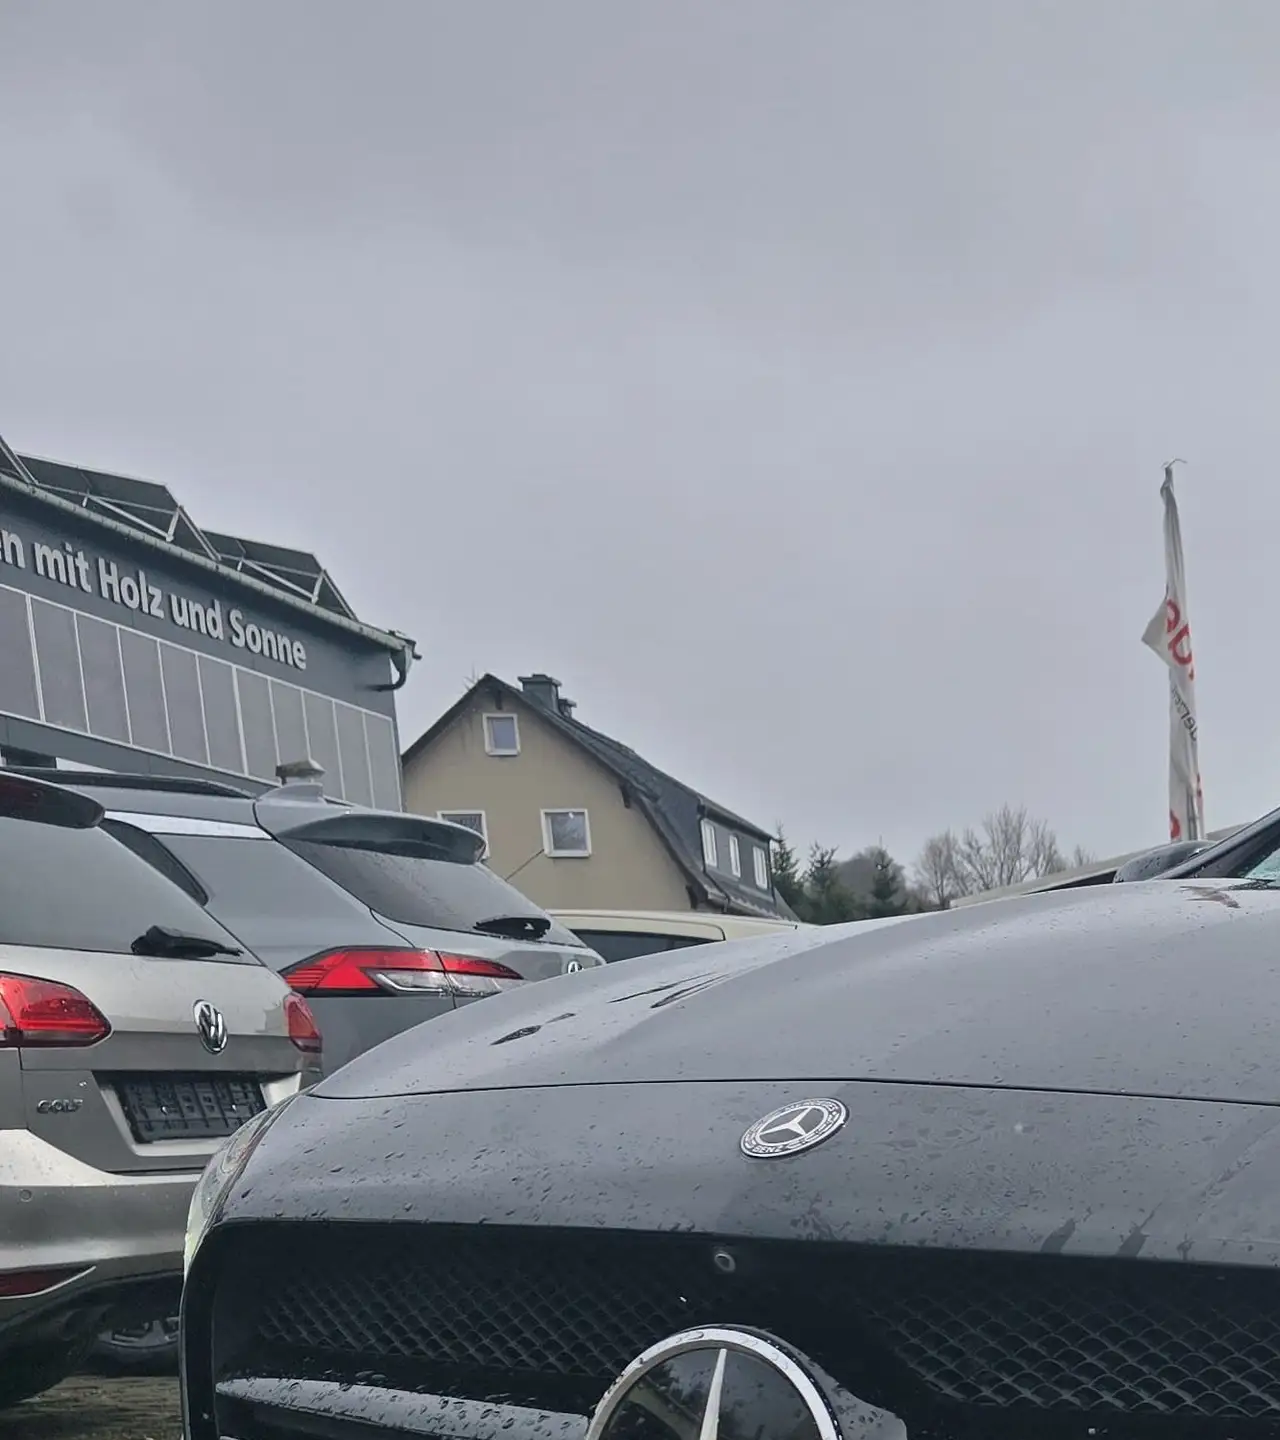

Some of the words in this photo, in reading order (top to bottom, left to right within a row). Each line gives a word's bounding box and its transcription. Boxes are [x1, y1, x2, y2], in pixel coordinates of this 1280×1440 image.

[0, 528, 27, 569] n
[33, 541, 93, 593] mit
[97, 556, 165, 620] Holz
[169, 592, 224, 640] und
[229, 607, 307, 670] Sonne
